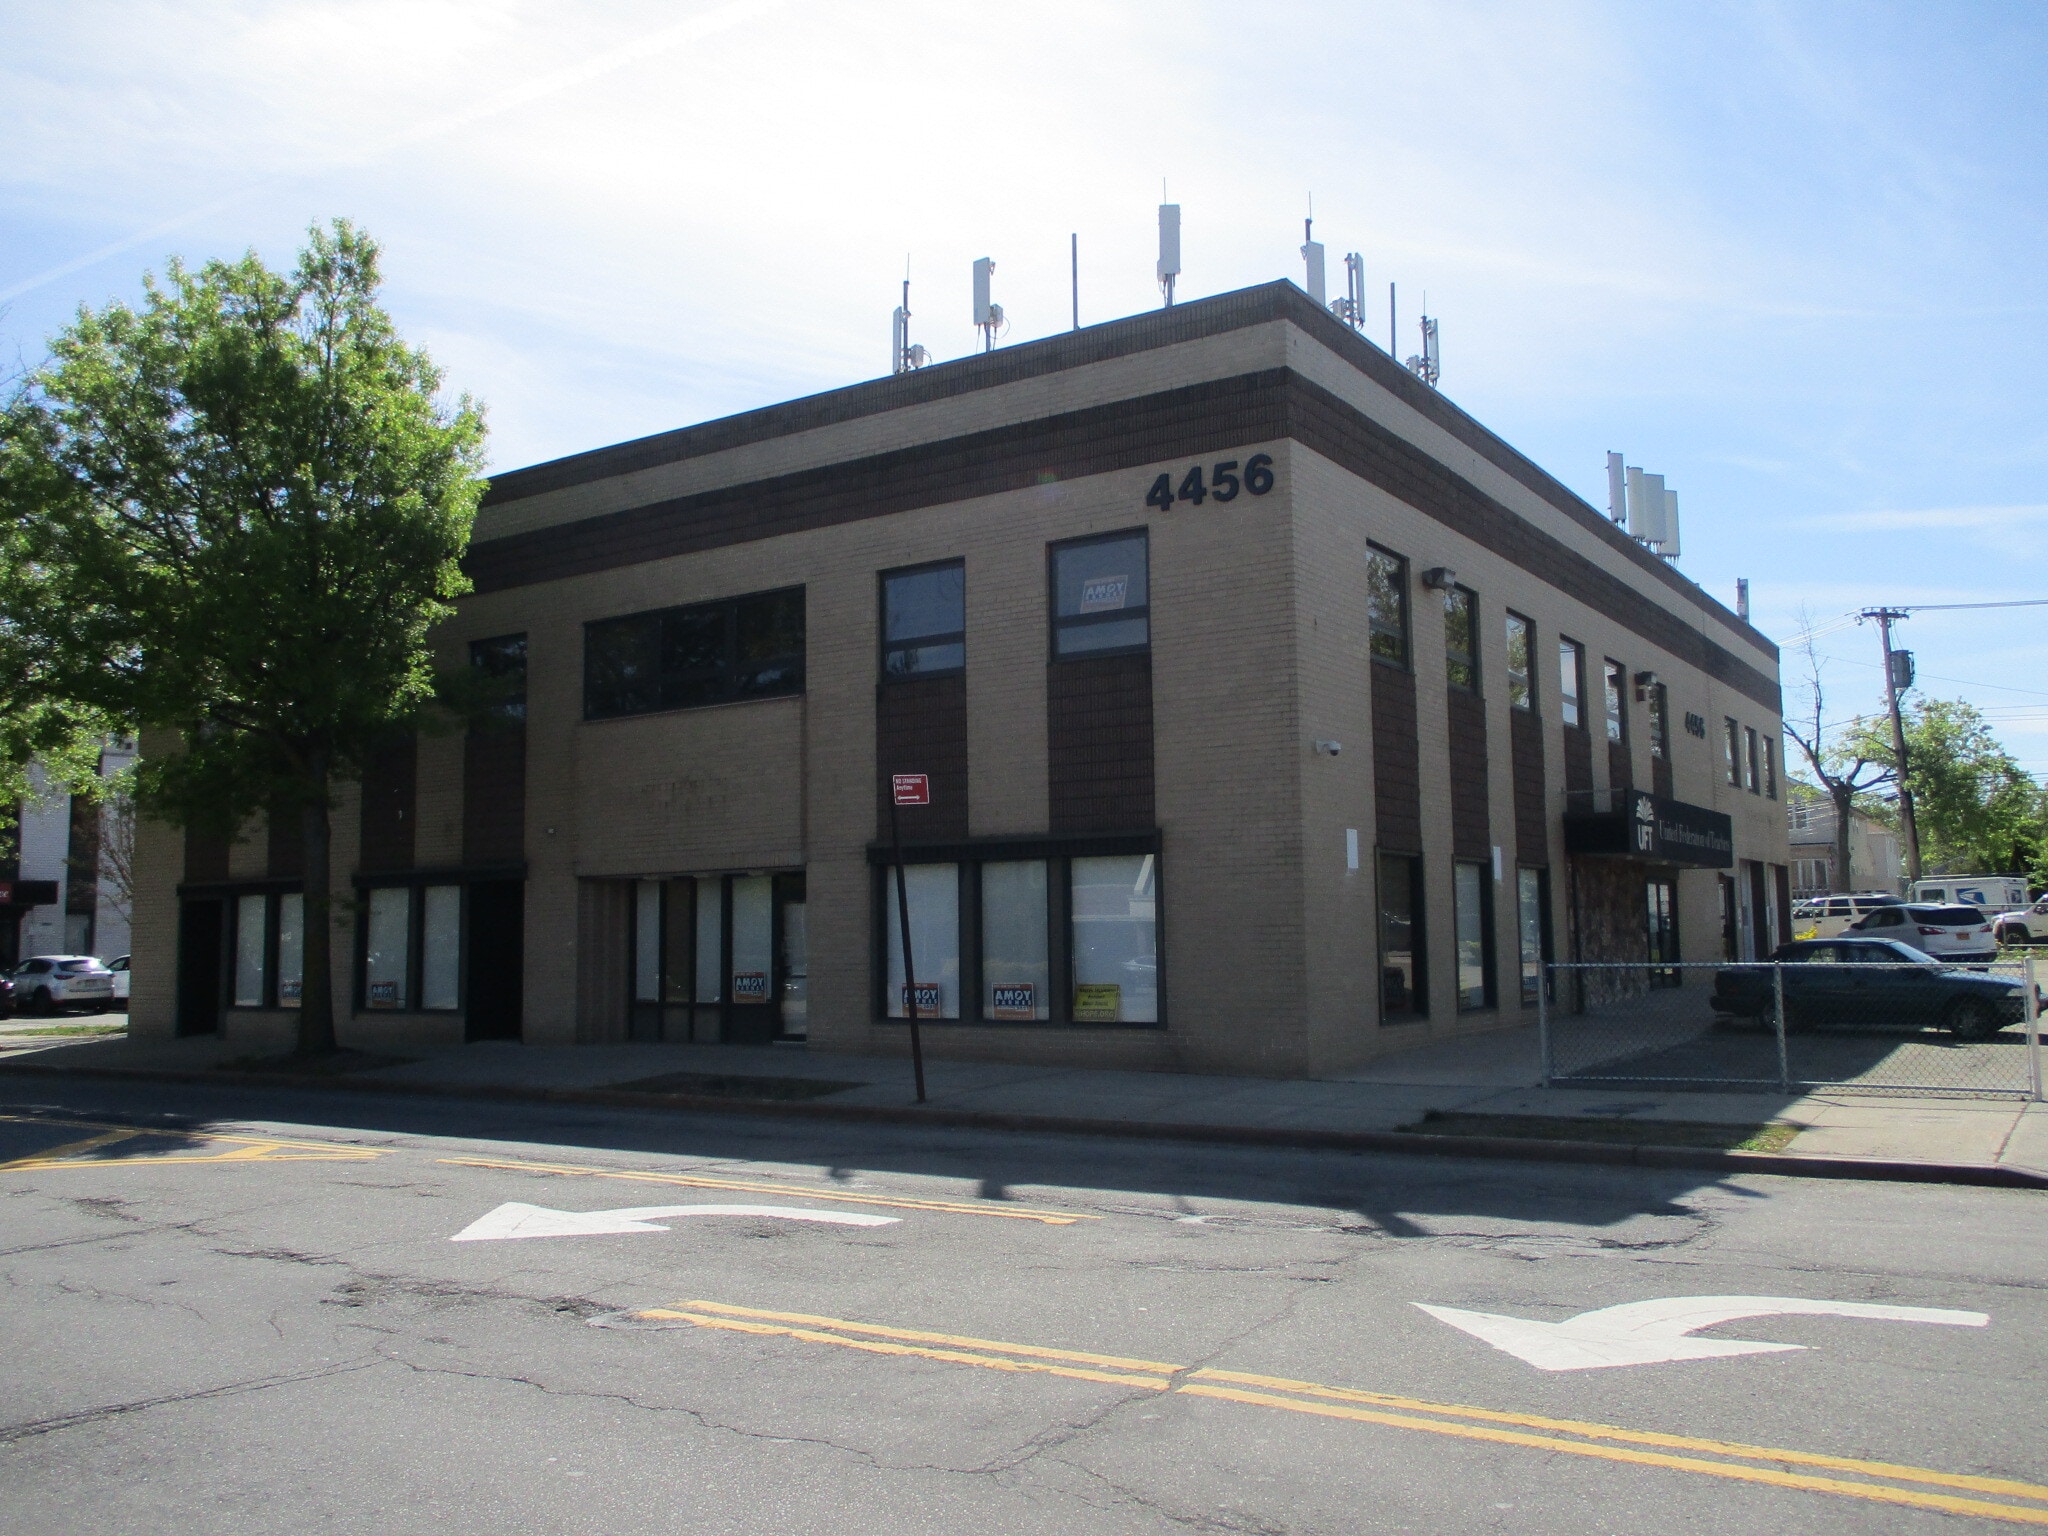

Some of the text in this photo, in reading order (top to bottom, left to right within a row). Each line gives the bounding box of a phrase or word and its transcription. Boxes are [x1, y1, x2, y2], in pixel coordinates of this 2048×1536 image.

[1146, 453, 1274, 512] 4456
[1086, 582, 1124, 596] AMOY
[1685, 711, 1705, 739] 4456
[1637, 824, 1653, 851] UFT
[1659, 819, 1679, 842] United
[1679, 824, 1705, 847] Federation
[736, 978, 764, 986] AMOY
[995, 990, 1031, 1000] AMOY
